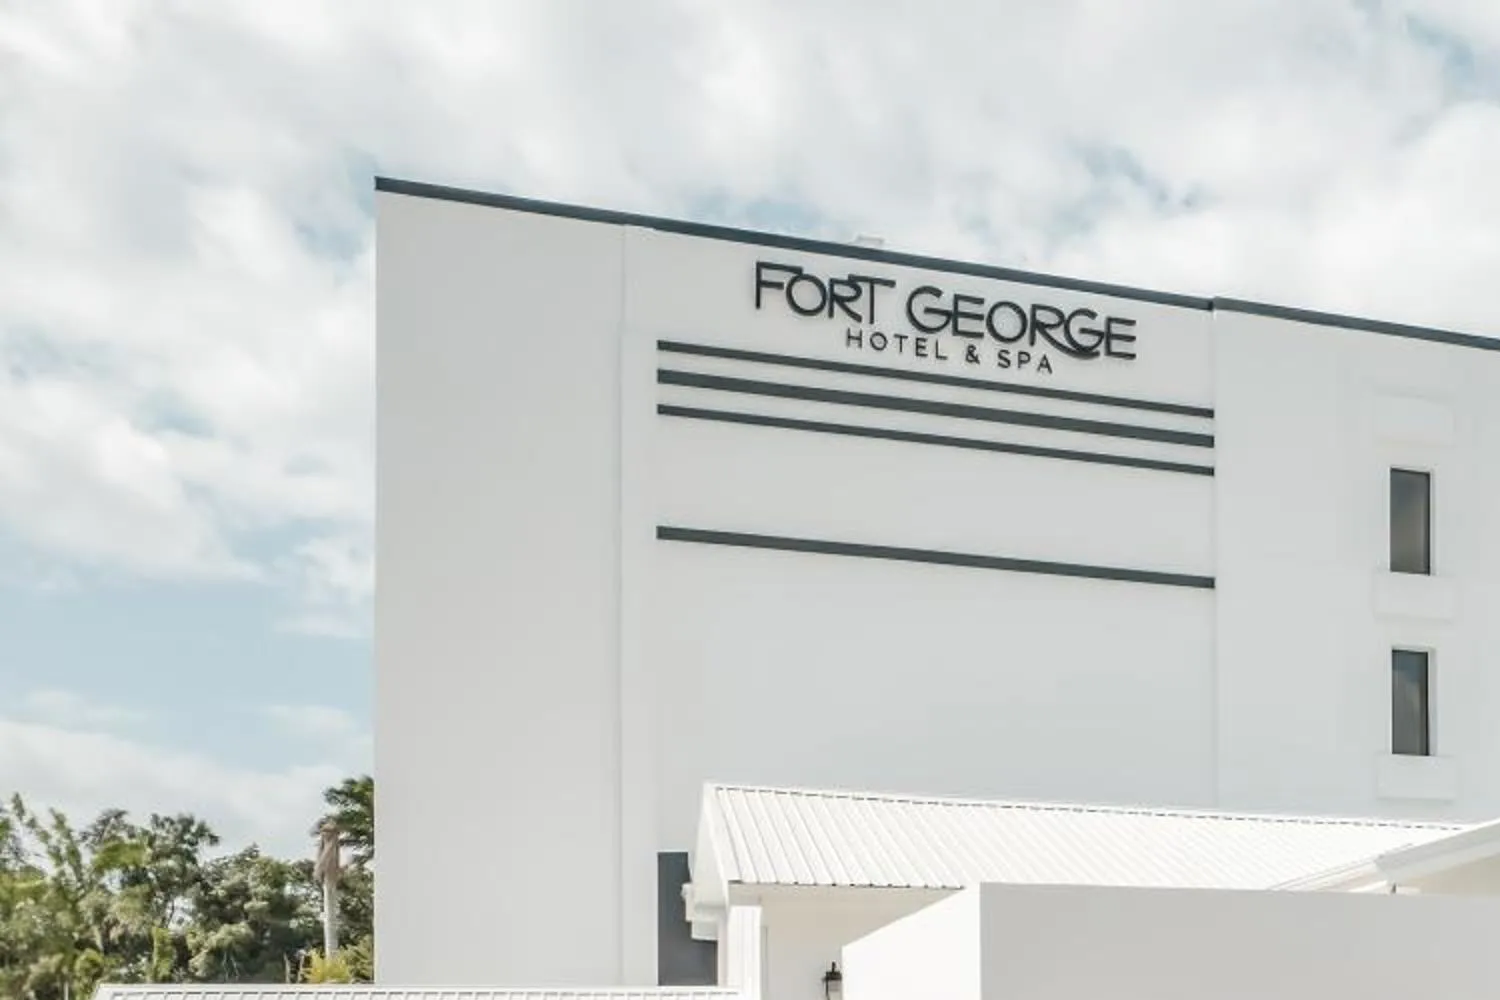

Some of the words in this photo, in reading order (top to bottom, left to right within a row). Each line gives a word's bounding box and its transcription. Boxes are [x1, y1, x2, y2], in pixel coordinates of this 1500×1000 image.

[755, 261, 896, 325] FORT
[906, 285, 1137, 360] GEORGE
[846, 328, 949, 361] HOTEL
[965, 345, 981, 365] &
[997, 349, 1053, 374] SPA
